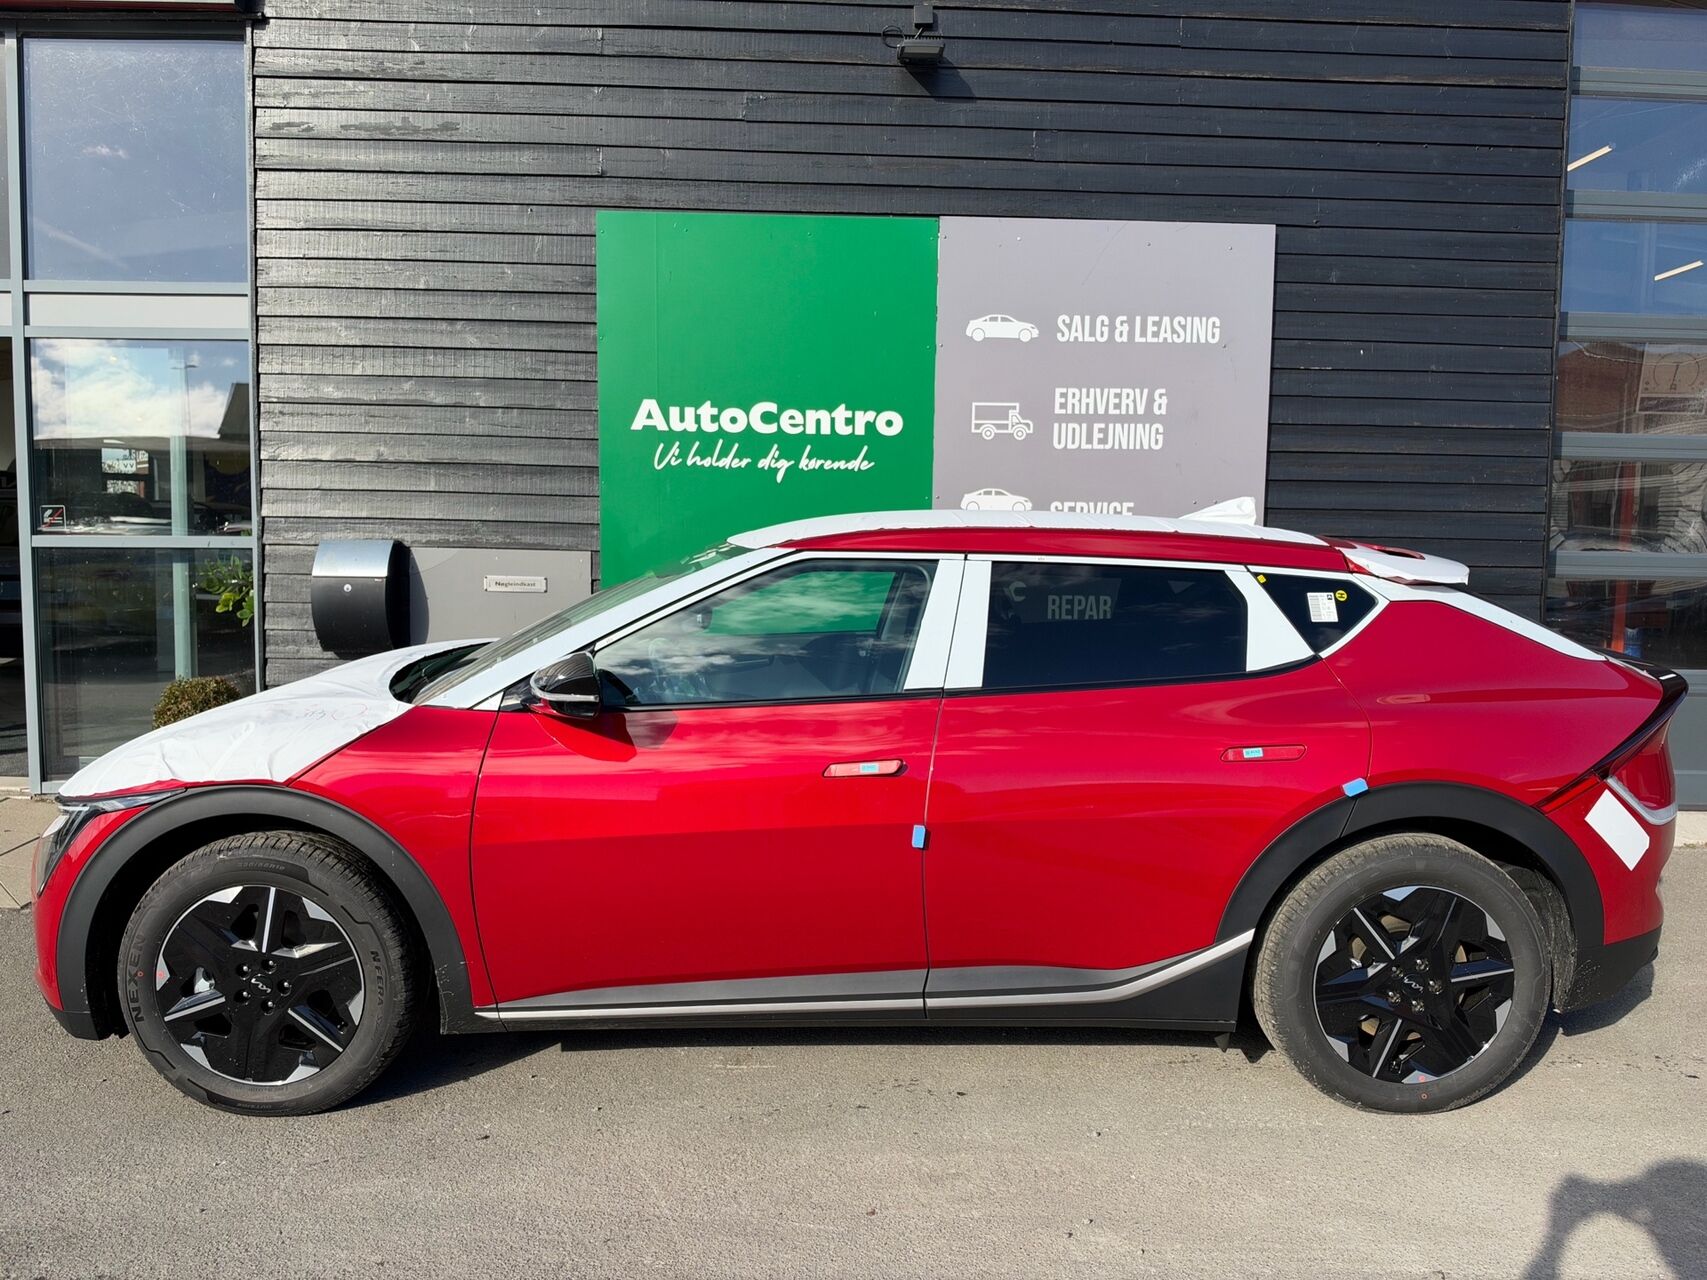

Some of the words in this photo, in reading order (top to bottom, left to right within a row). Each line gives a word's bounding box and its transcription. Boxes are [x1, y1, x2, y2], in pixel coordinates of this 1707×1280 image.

[1056, 315, 1110, 342] SALG
[1114, 315, 1129, 343] &
[1135, 315, 1221, 344] LEASING
[630, 398, 904, 437] AutoCentro
[1054, 387, 1149, 415] ERHVERV
[1153, 388, 1168, 416] &
[1052, 422, 1164, 450] UDLEJNING
[653, 441, 682, 471] Vi
[687, 439, 751, 469] holder
[757, 444, 796, 483] dig
[127, 934, 146, 1023] NEXEN
